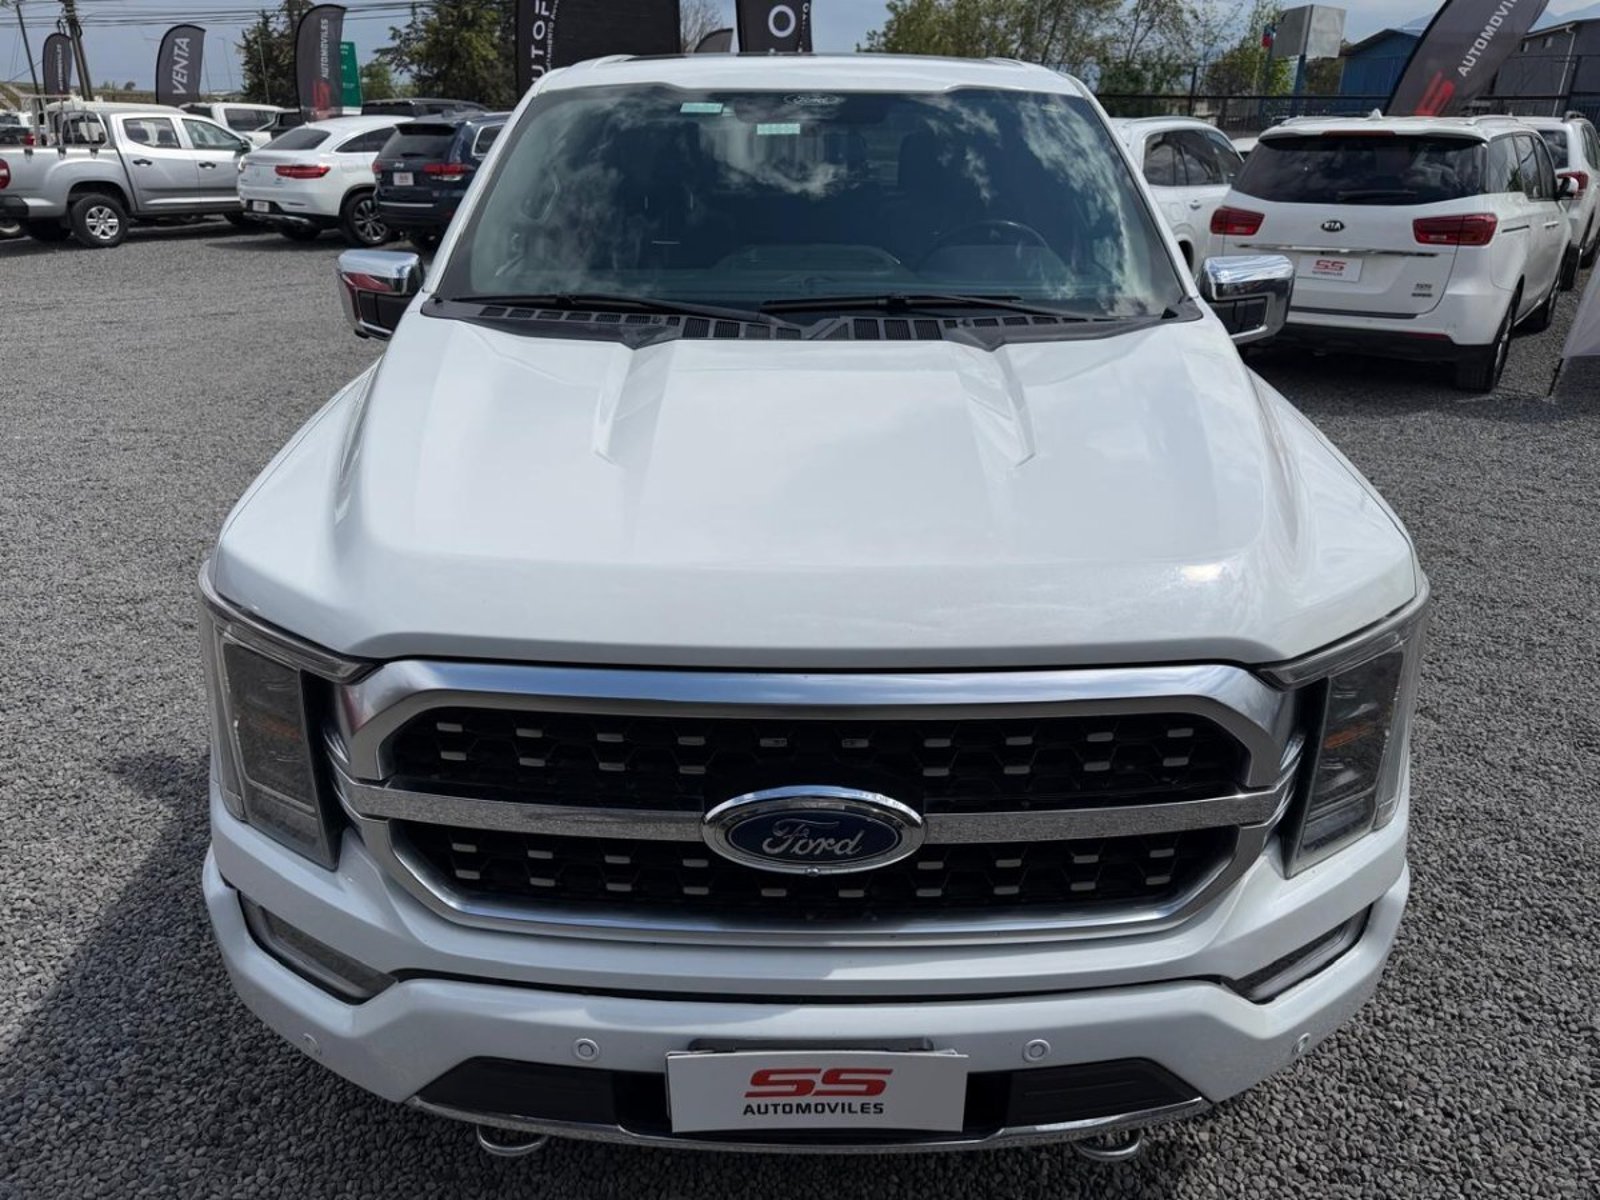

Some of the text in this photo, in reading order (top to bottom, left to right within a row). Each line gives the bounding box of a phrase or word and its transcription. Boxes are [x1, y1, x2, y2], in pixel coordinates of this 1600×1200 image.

[172, 38, 191, 95] VENTA
[1323, 221, 1342, 231] KIA
[762, 818, 865, 856] Ford
[744, 1067, 894, 1099] SS
[742, 1101, 885, 1117] AUTOMOVILES
